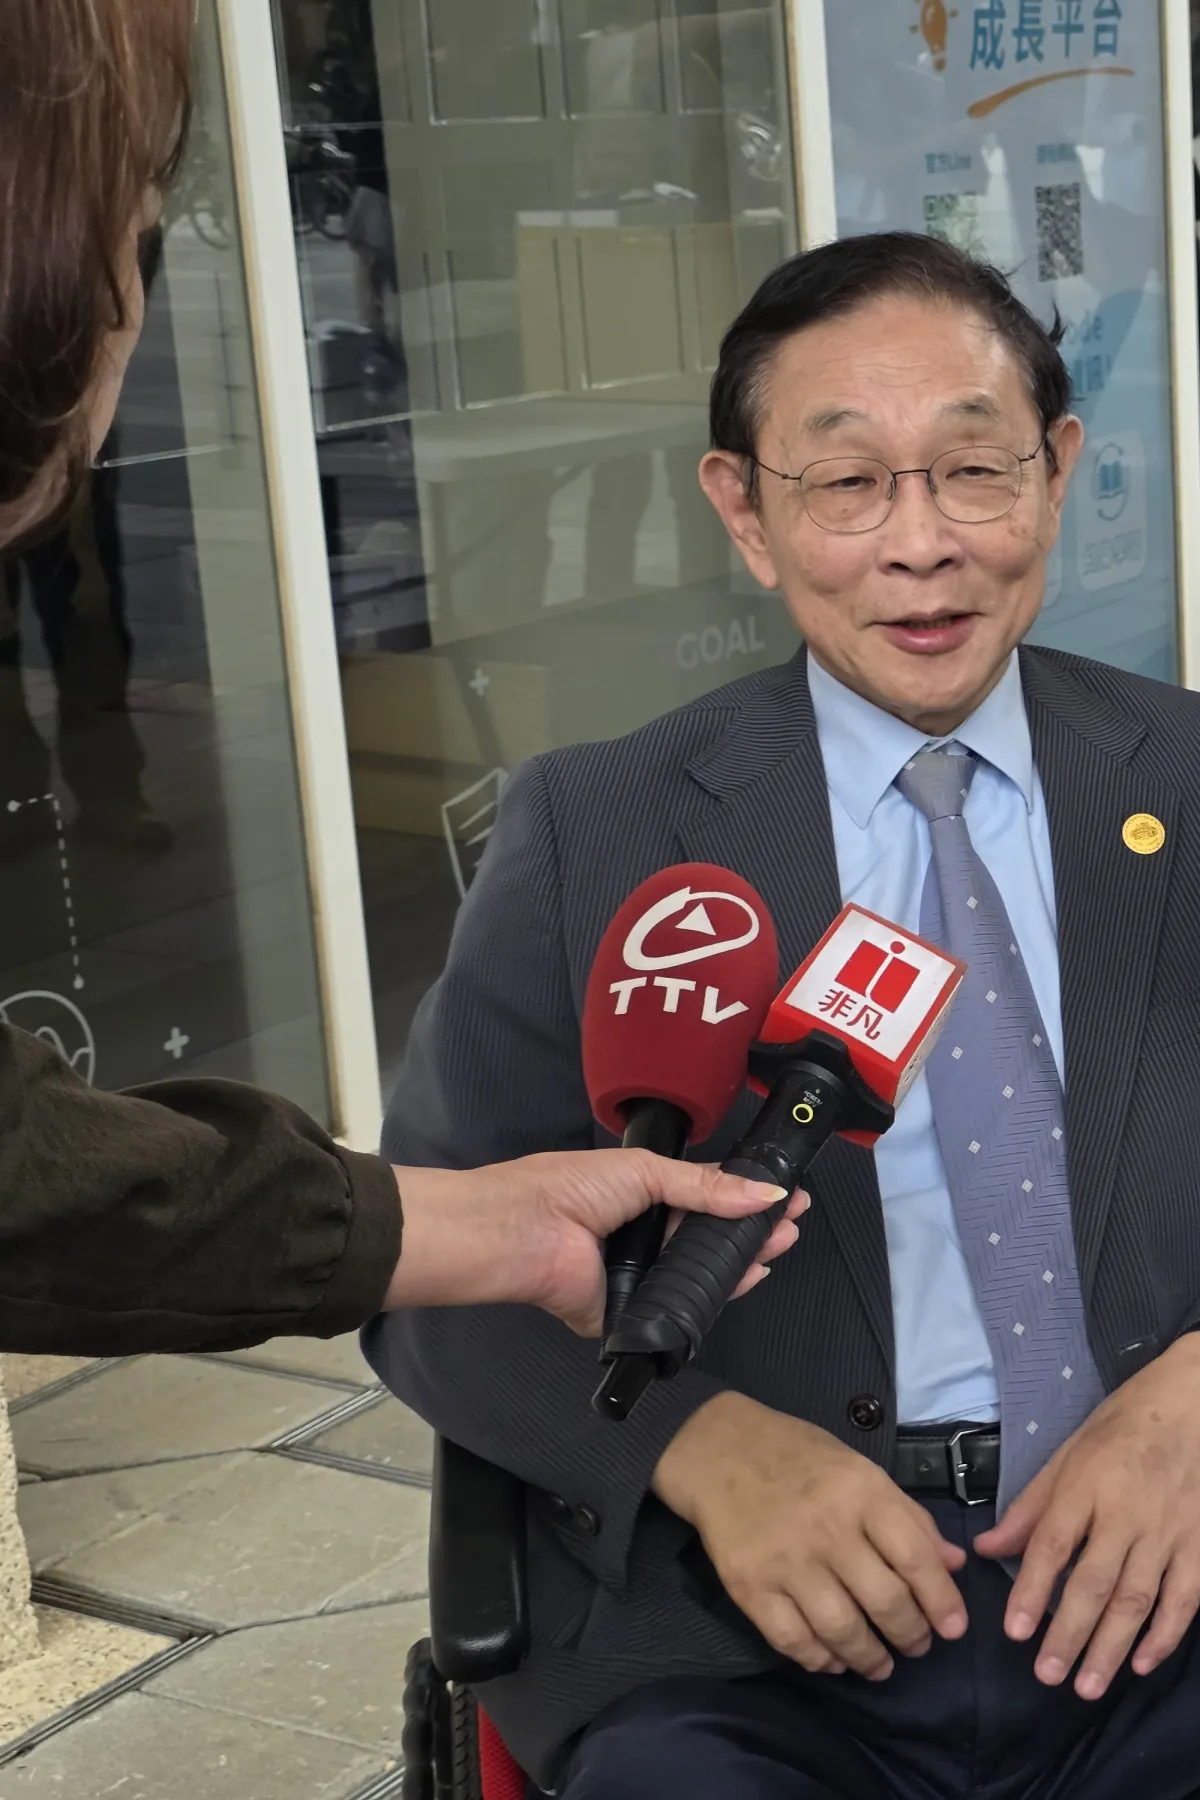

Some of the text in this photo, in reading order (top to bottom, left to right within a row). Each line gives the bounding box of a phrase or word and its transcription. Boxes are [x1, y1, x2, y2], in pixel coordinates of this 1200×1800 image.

[969, 0, 1122, 70] 成長平台
[676, 614, 766, 671] GOAL
[609, 976, 749, 1025] TTV
[817, 988, 884, 1040] 非凡
